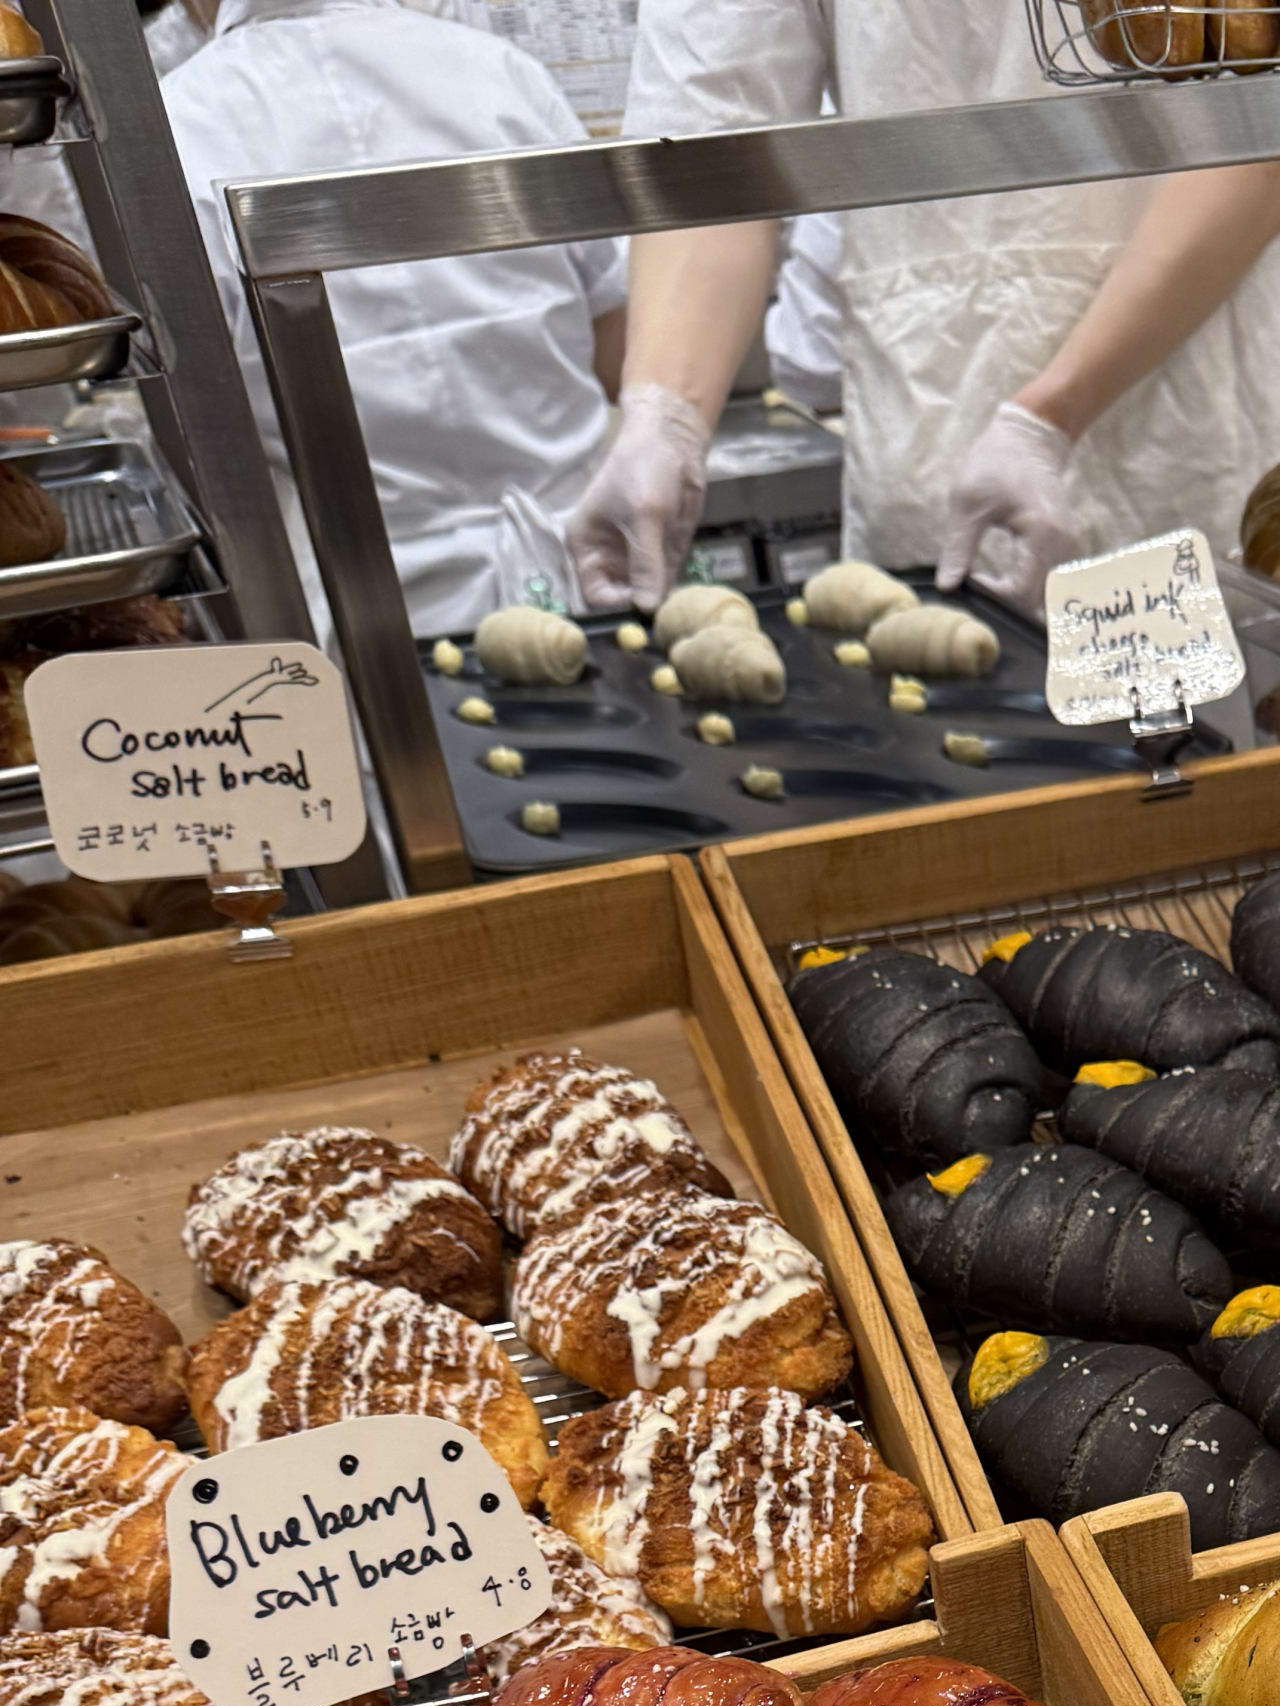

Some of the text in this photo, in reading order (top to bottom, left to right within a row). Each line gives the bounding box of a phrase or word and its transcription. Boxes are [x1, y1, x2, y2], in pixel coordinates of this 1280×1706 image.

[1064, 581, 1189, 636] Squid ink
[82, 711, 283, 763] Coconut
[131, 749, 311, 799] salt bread
[77, 823, 236, 852] 코코넛 소금빵
[190, 1477, 437, 1589] Blueberry
[254, 1521, 474, 1619] salt bread
[390, 1607, 456, 1650] 소금빵
